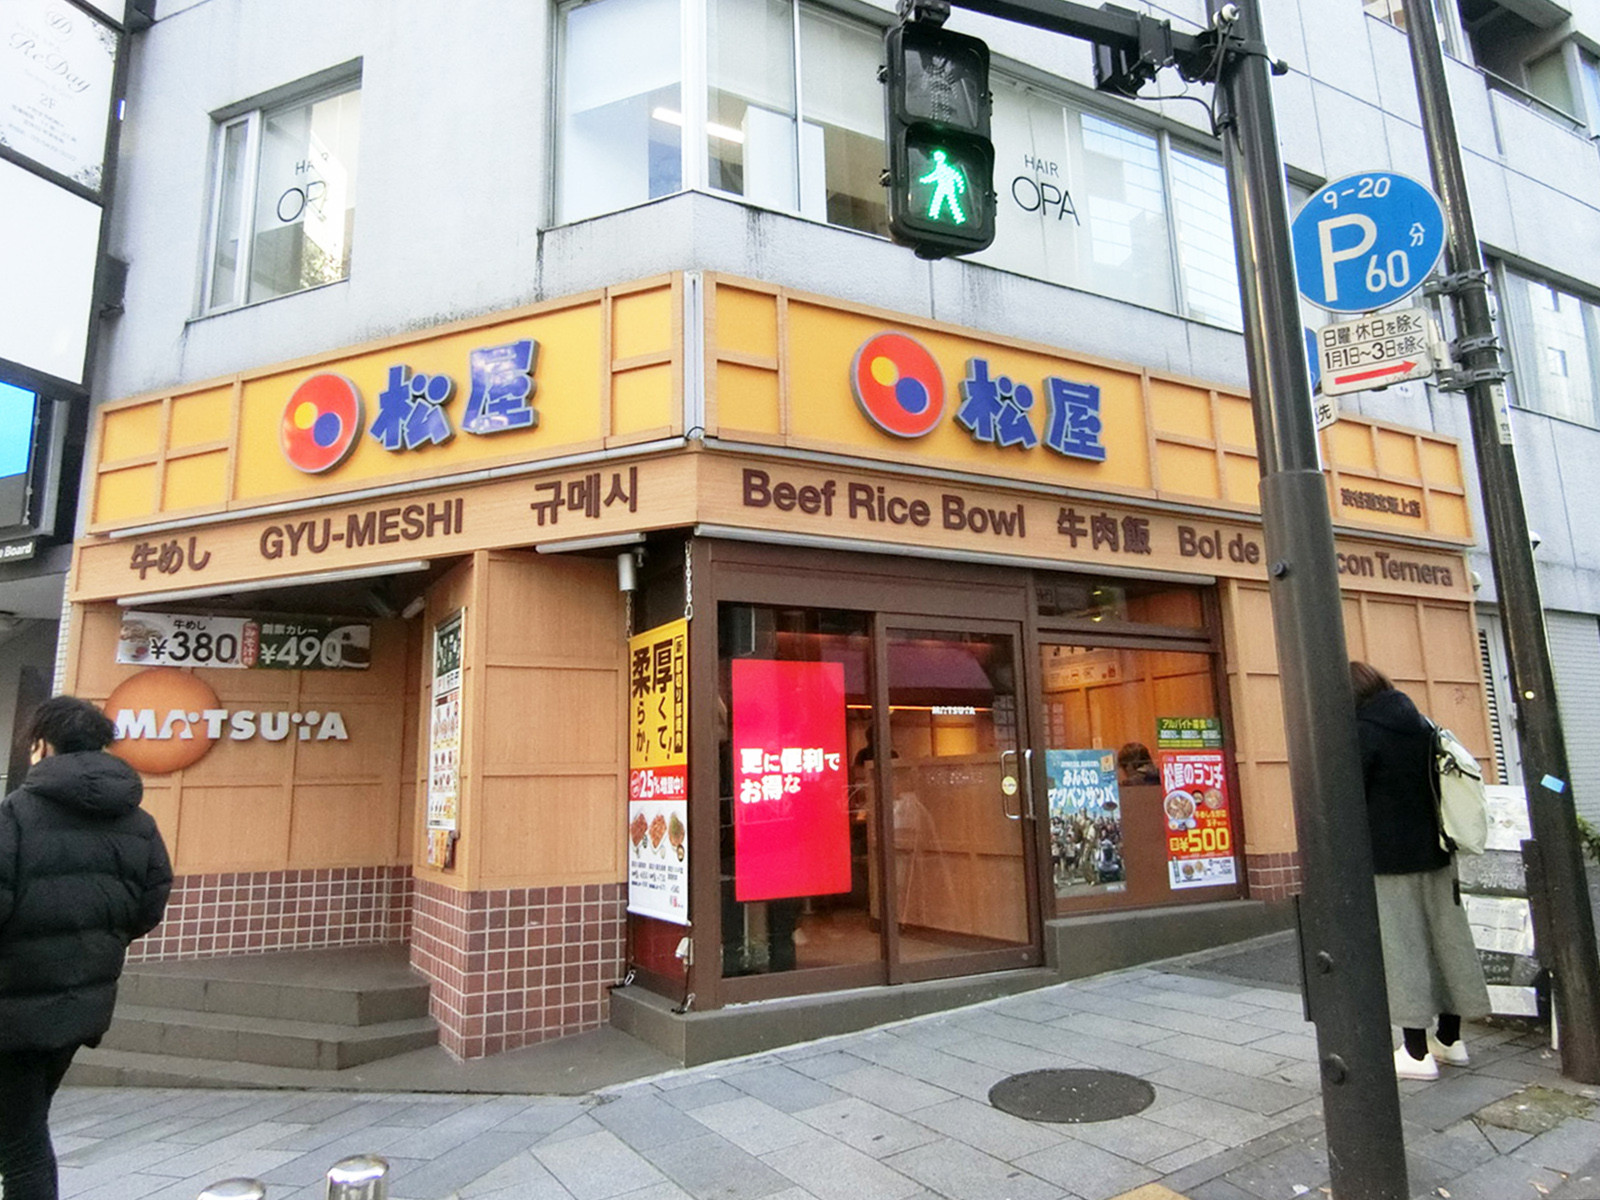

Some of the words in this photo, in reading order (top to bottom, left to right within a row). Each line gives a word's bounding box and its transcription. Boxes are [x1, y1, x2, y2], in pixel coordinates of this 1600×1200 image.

[1024, 154, 1059, 178] HAIR
[1012, 176, 1080, 226] OPA
[1323, 177, 1391, 210] 9-20
[1409, 222, 1425, 247] 分
[1318, 213, 1377, 302] P
[1366, 250, 1410, 292] 60
[369, 339, 540, 452] 松屋
[953, 358, 1107, 462] 松屋
[530, 466, 638, 526] 규메시
[742, 468, 836, 516] Beef
[848, 482, 931, 527] Rice
[941, 494, 1026, 538] Bowl
[259, 498, 464, 560] GYU-MESHI
[1057, 507, 1152, 555] 牛肉飯
[130, 537, 211, 580] 牛めし
[1178, 525, 1222, 560] Bol
[1228, 533, 1260, 564] de
[1375, 551, 1453, 587] Ternera
[174, 619, 206, 630] 牛めし
[151, 631, 237, 662] ¥380
[261, 637, 342, 666] ¥490
[740, 747, 840, 774] 更に便利で
[1163, 763, 1223, 793] 松屋のランチ
[740, 774, 801, 804] お得な
